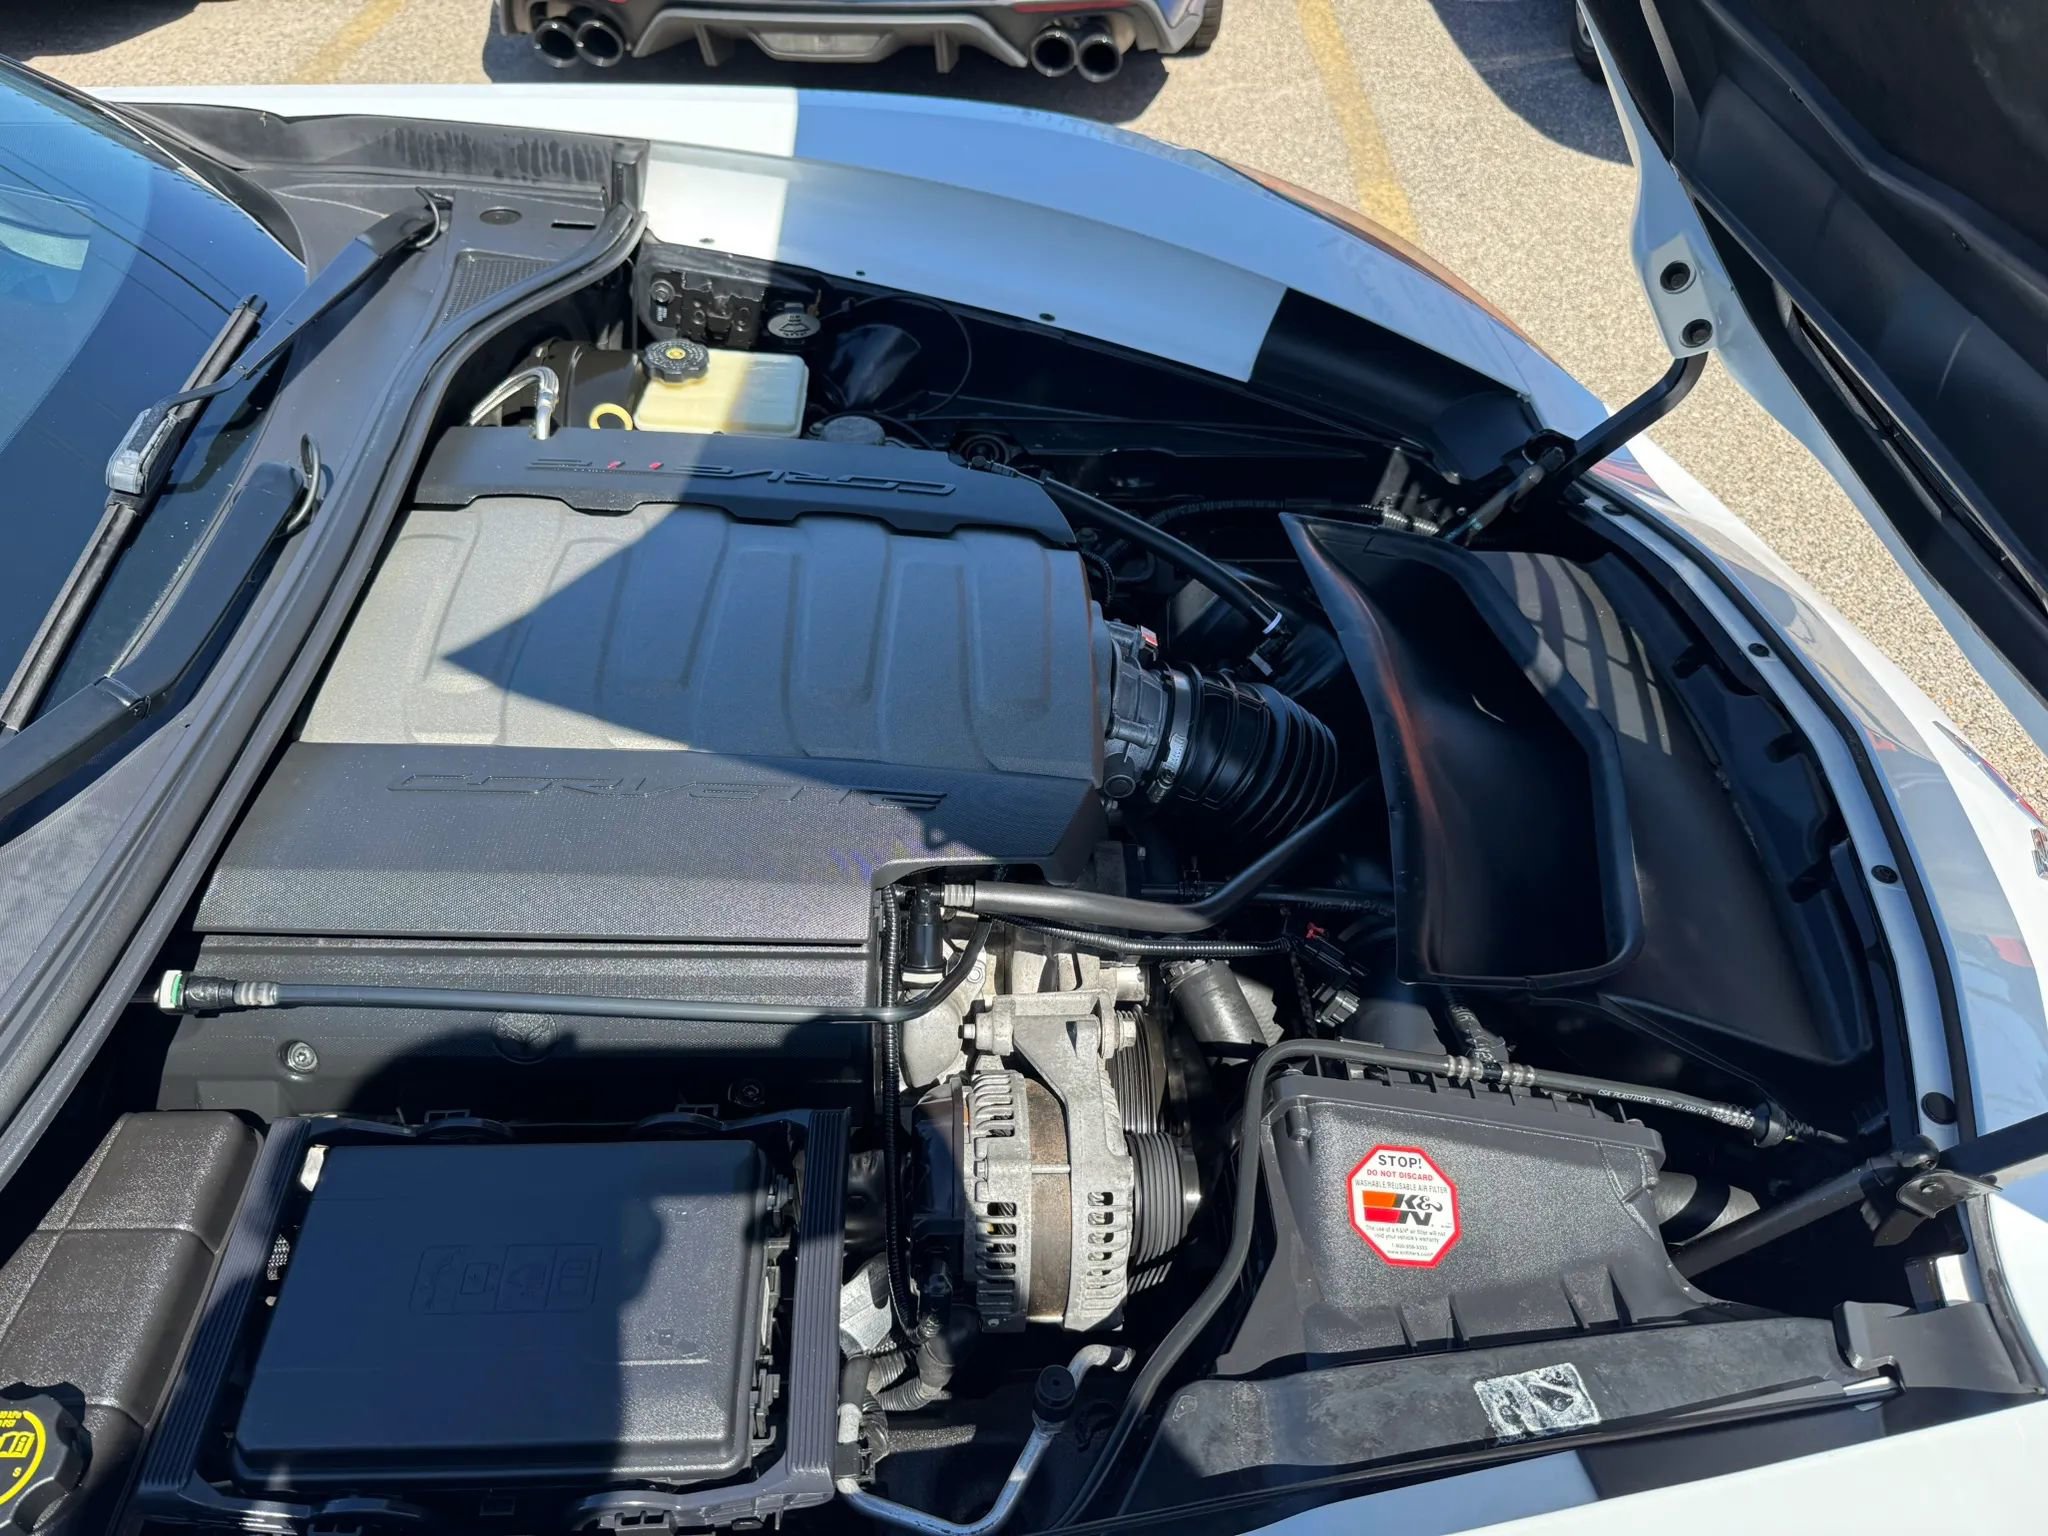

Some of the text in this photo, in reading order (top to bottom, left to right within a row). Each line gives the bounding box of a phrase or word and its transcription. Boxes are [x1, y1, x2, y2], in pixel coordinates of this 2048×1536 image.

[387, 773, 948, 811] CORVETTE
[1378, 1154, 1423, 1170] STOP!
[1366, 1169, 1434, 1182] DO NOT DISCARD
